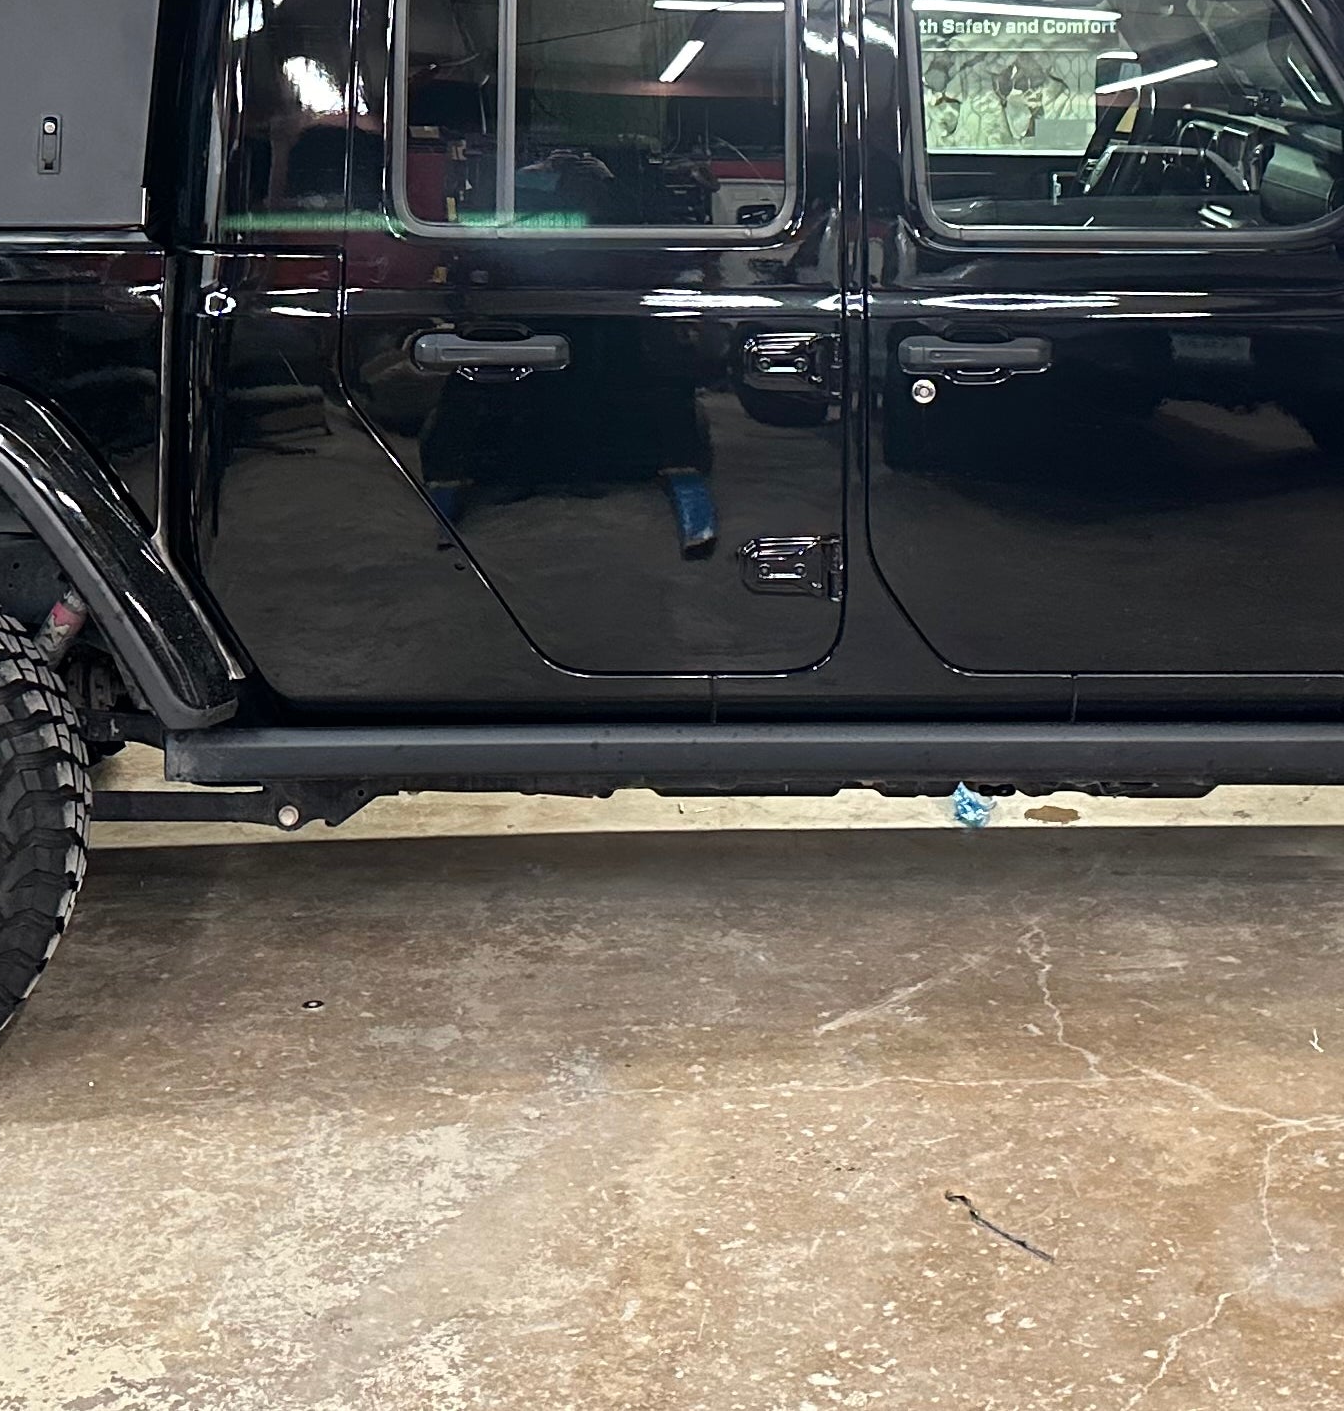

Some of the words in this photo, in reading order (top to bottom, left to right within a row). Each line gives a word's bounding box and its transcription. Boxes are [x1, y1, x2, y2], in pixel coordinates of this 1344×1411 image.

[942, 18, 1001, 36] Safety
[1006, 19, 1039, 34] and
[1043, 19, 1117, 34] Comfort
